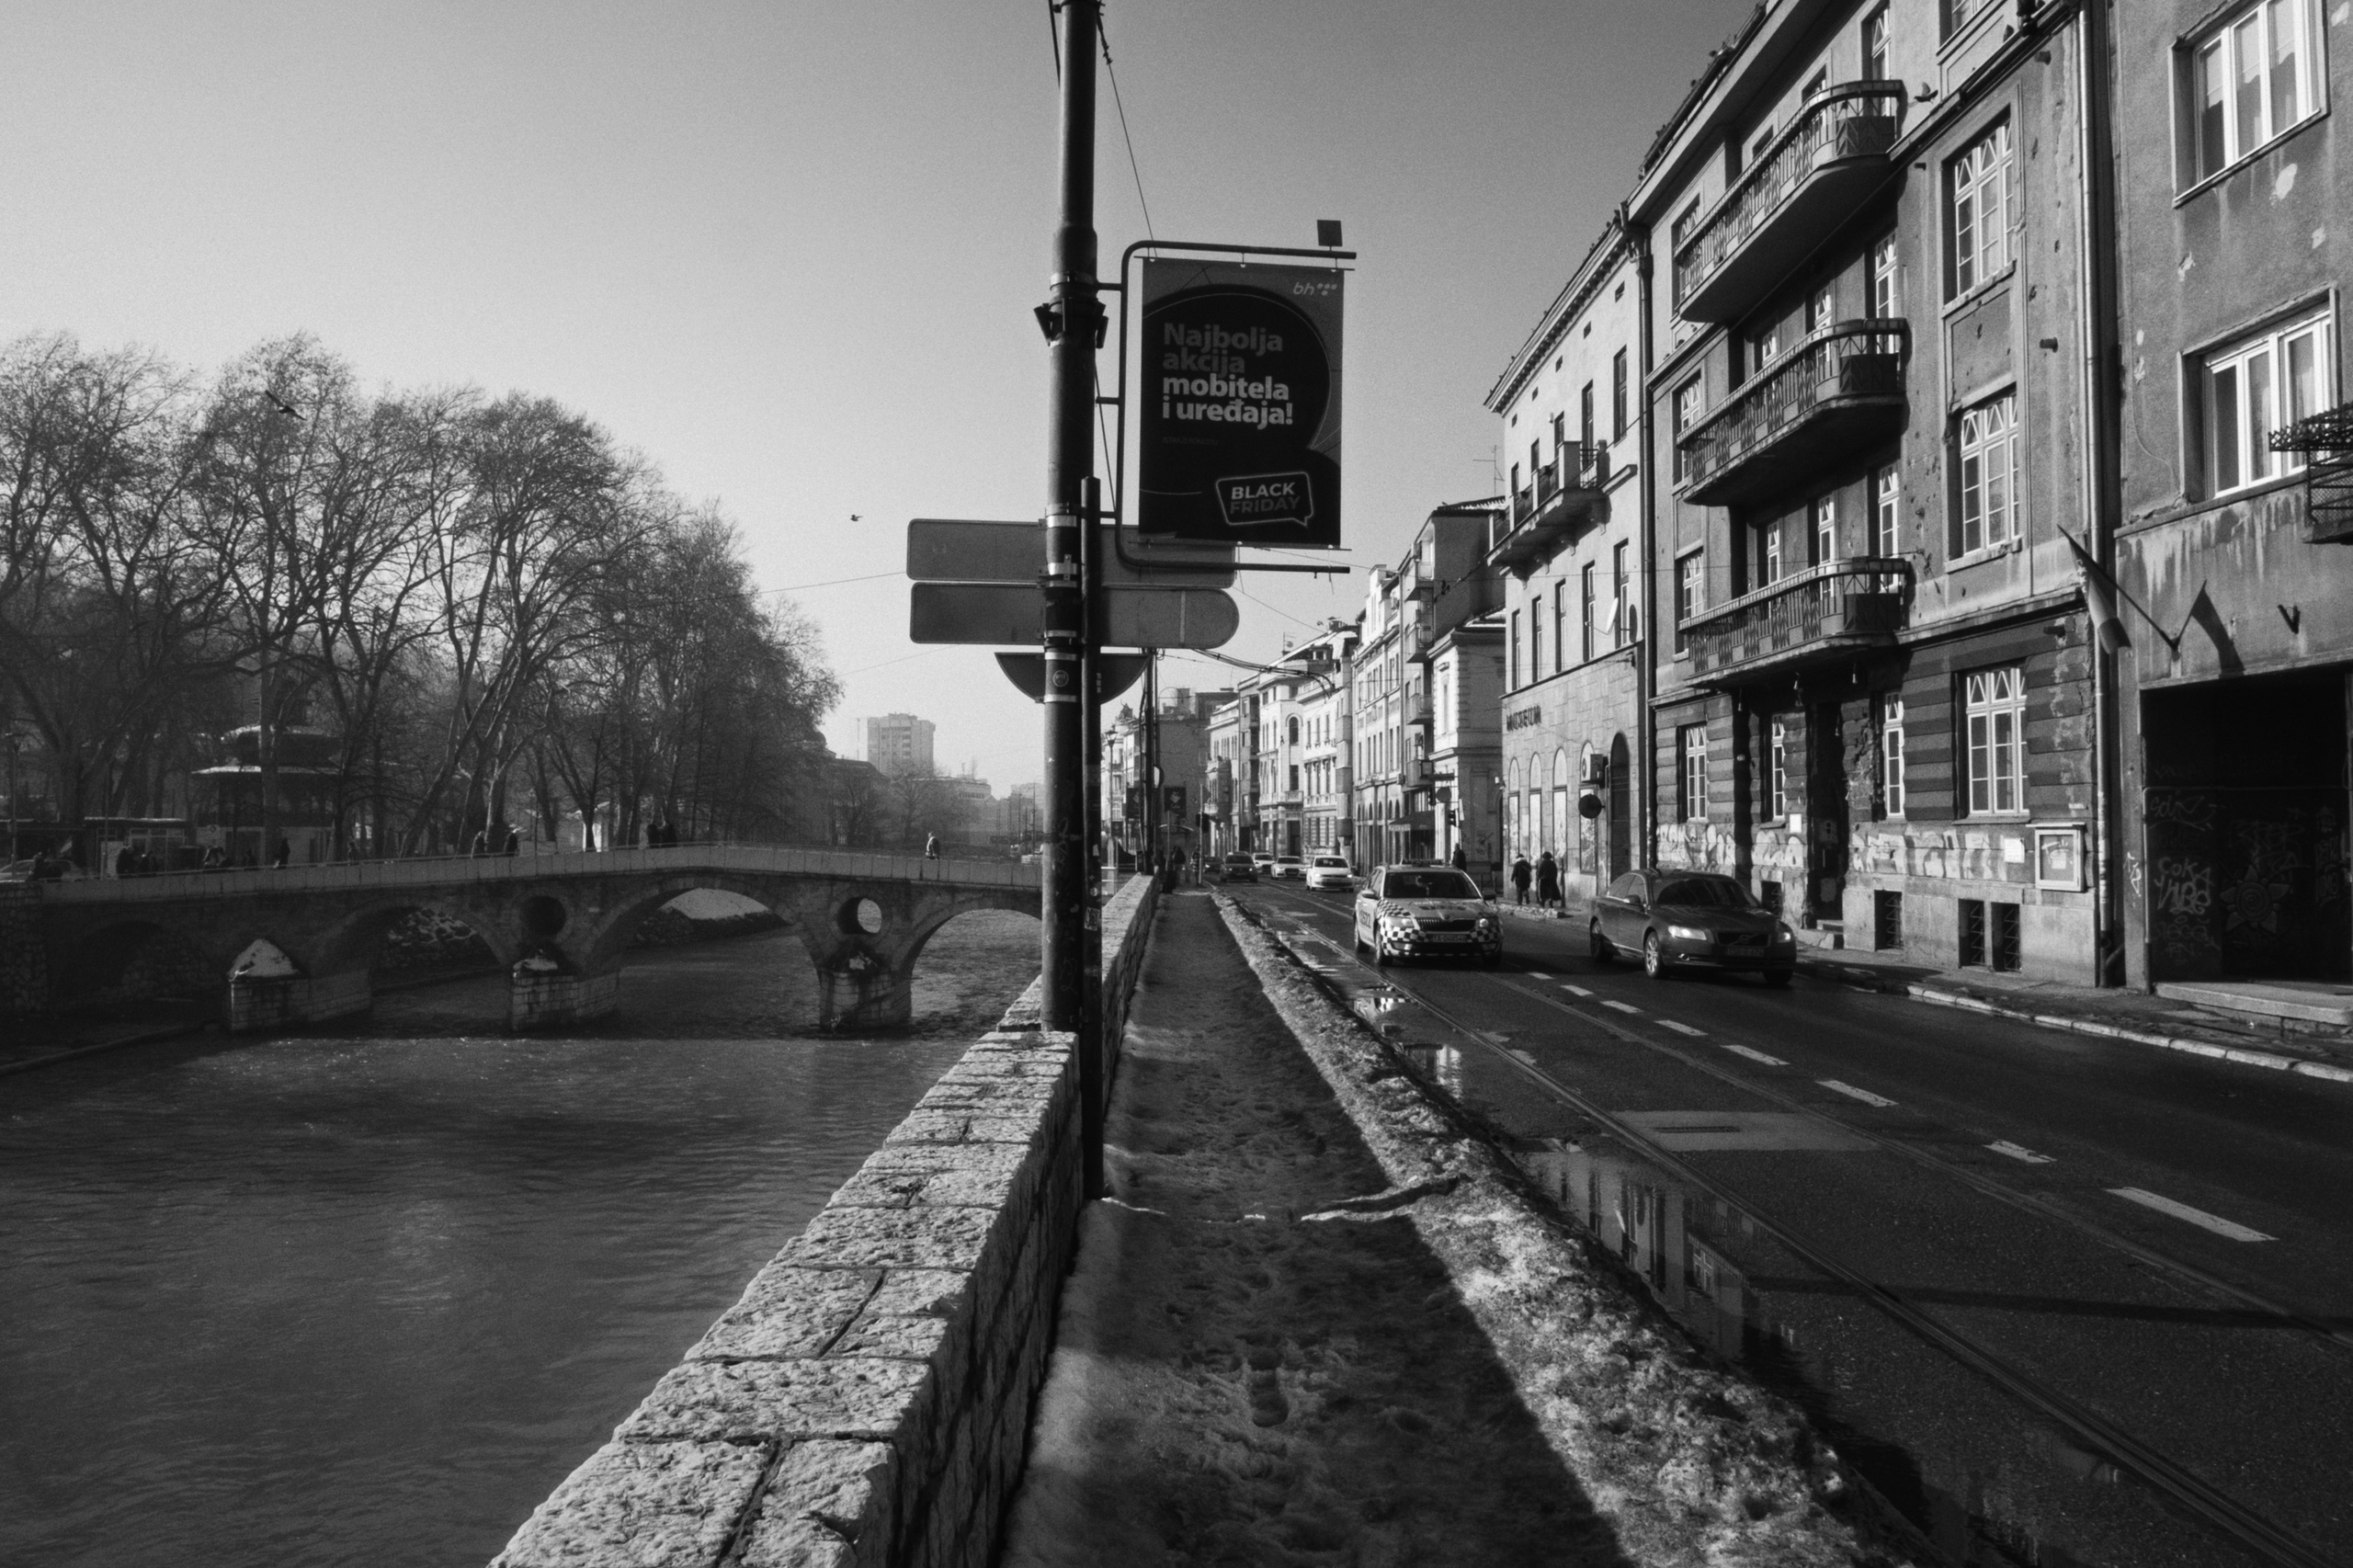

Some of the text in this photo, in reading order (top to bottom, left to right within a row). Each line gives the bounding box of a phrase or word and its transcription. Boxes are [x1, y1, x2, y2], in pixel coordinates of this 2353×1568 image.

[1164, 323, 1283, 357] Najbolja
[1163, 347, 1245, 379] akcija
[1163, 372, 1290, 400] mobitela
[1163, 395, 1293, 430] i uređaja!
[1230, 495, 1301, 514] FRIDAY
[1232, 482, 1295, 500] BLACK
